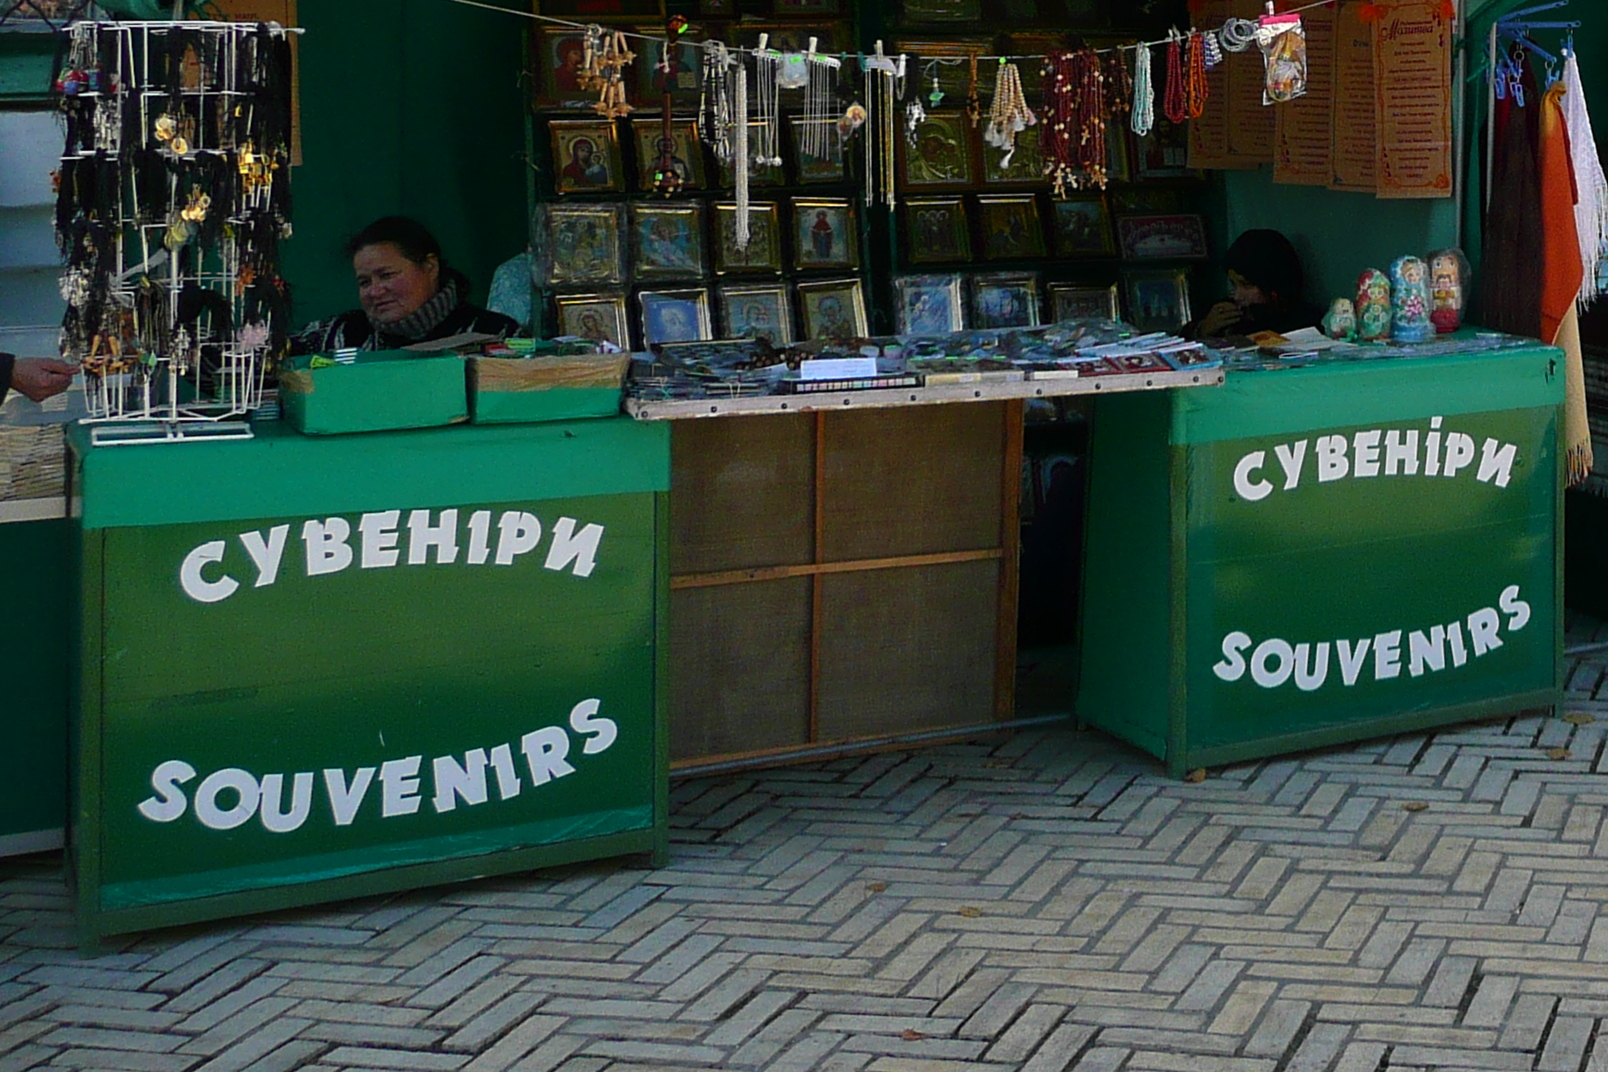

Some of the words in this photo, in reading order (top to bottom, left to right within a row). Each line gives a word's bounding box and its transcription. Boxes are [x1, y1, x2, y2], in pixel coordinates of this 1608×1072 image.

[1233, 416, 1518, 501] СУВЕНІРИ
[180, 509, 604, 603] СУВЕНІРИ
[1213, 585, 1531, 690] SOUVENIRS
[138, 698, 618, 833] SOUVENIRS
